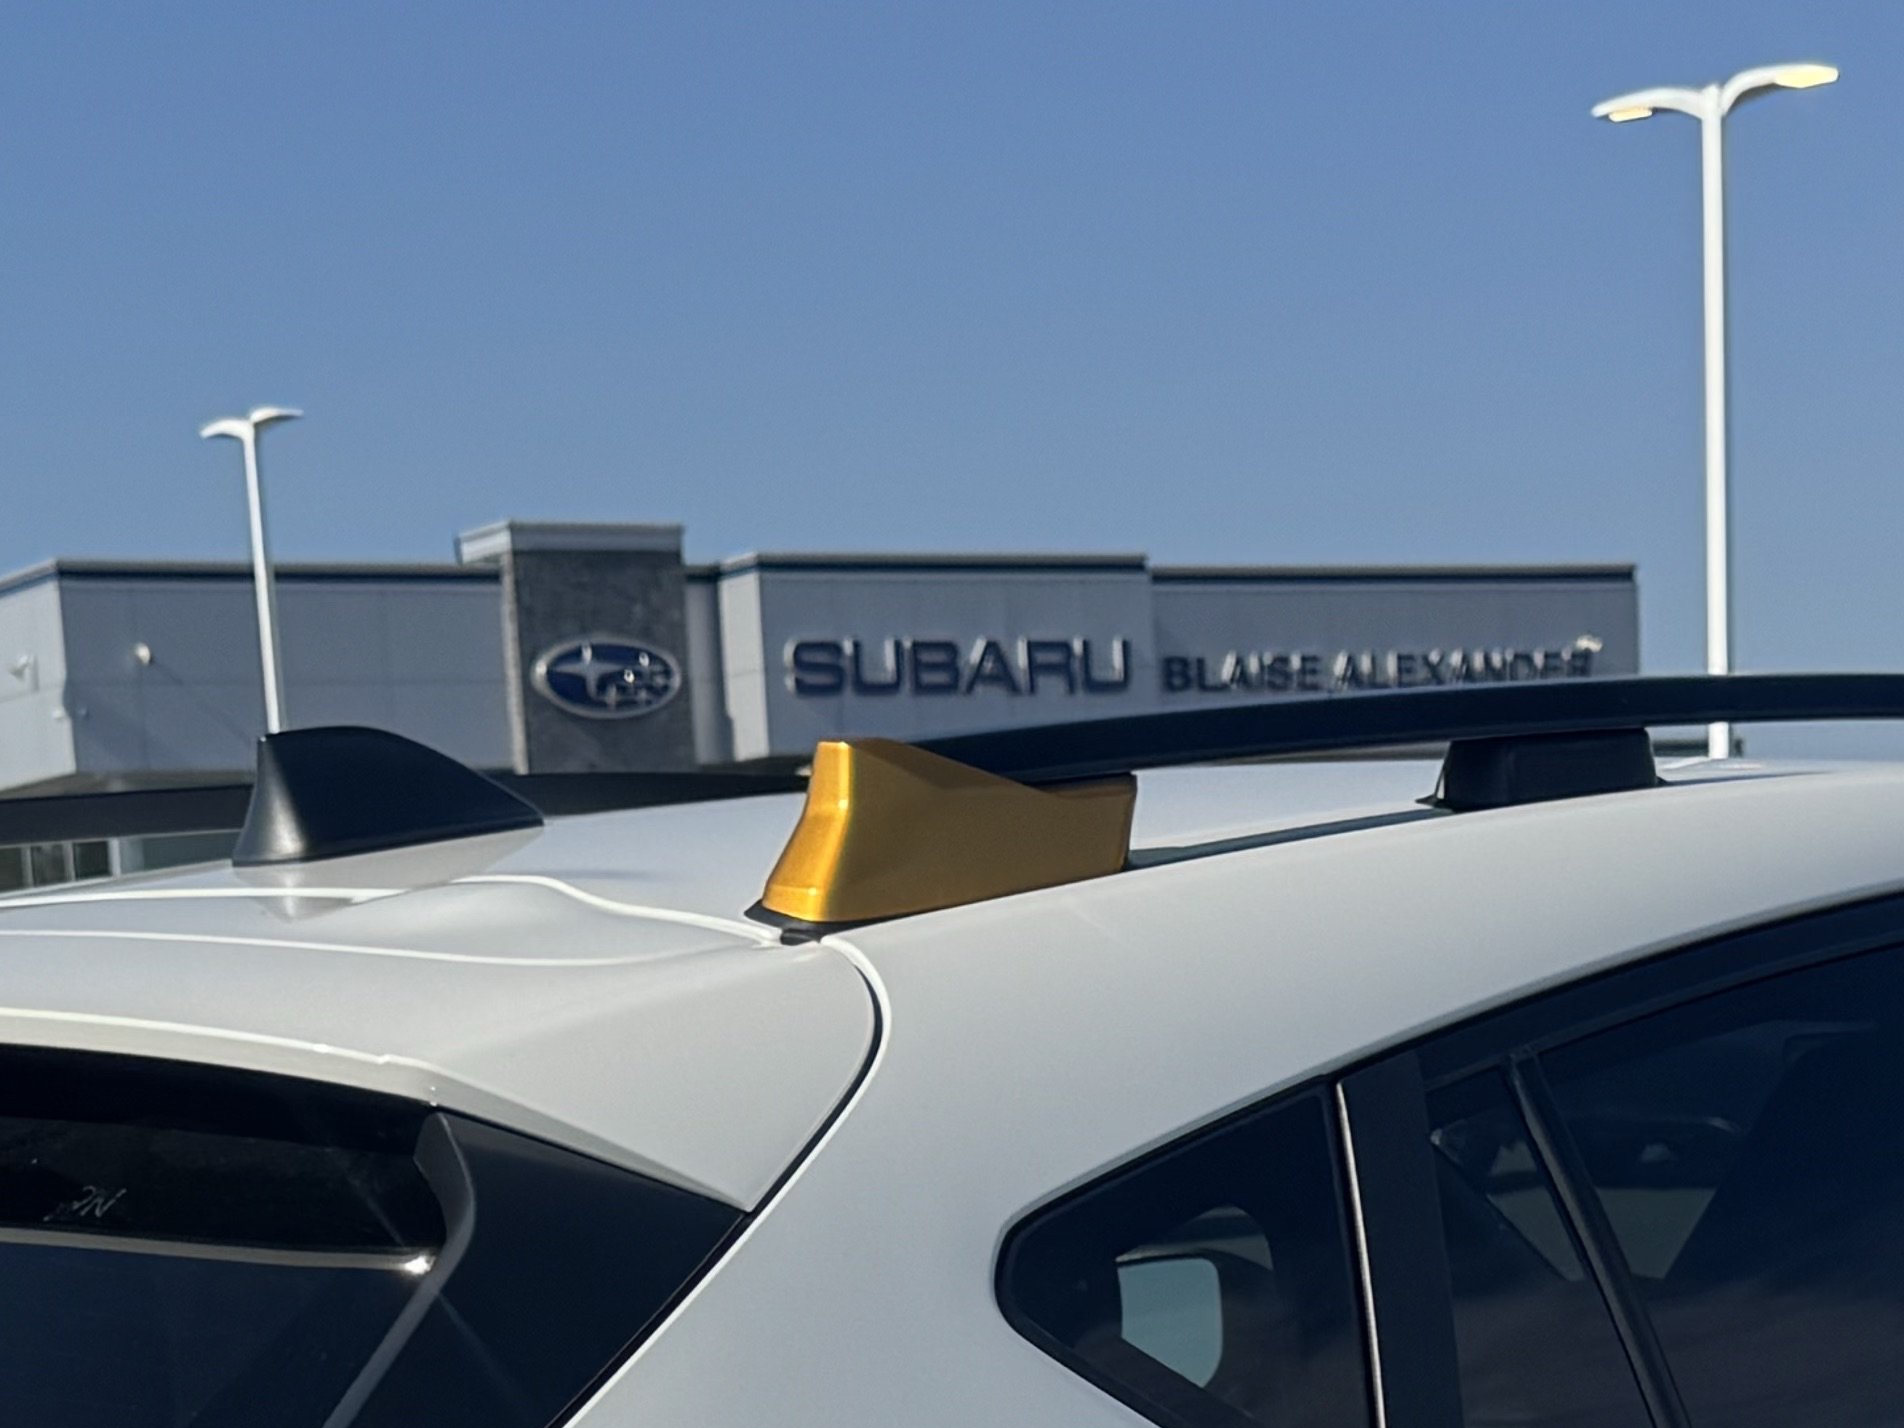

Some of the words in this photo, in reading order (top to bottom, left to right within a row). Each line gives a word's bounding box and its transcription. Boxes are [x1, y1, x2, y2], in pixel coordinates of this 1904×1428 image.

[786, 636, 1132, 696] SUBARU
[1161, 650, 1322, 693] BLAISE
[1333, 644, 1596, 691] ALEXANDER
